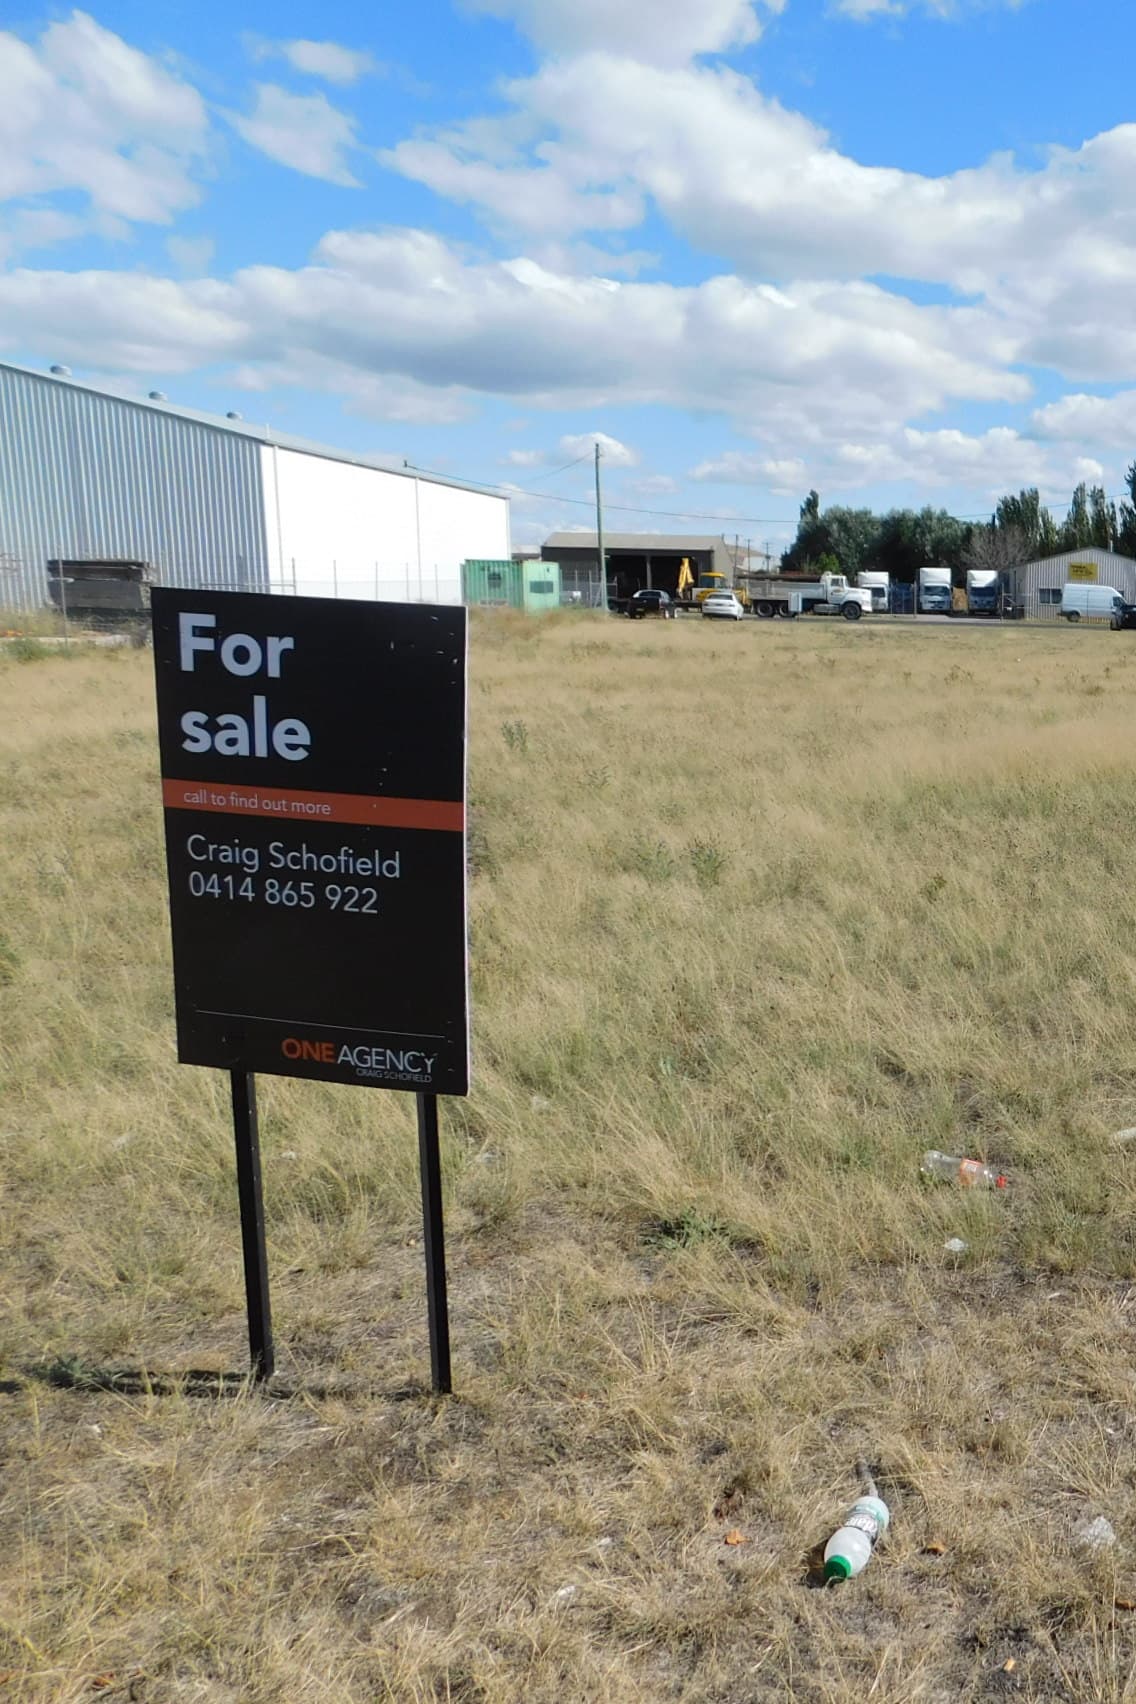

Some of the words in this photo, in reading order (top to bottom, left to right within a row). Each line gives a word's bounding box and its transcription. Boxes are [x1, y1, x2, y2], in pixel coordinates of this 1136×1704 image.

[178, 612, 295, 678] For
[180, 695, 311, 761] sale
[183, 789, 207, 804] call
[211, 792, 227, 806] to
[230, 791, 258, 809] find
[262, 799, 288, 812] out
[291, 802, 331, 815] more
[187, 834, 259, 873] Craig
[269, 841, 400, 878] Schofield
[189, 871, 255, 902] 0414
[265, 879, 315, 908] 865
[325, 884, 378, 914] 922
[355, 1068, 382, 1078] CRAIG
[383, 1071, 432, 1083] SCHOFIELD
